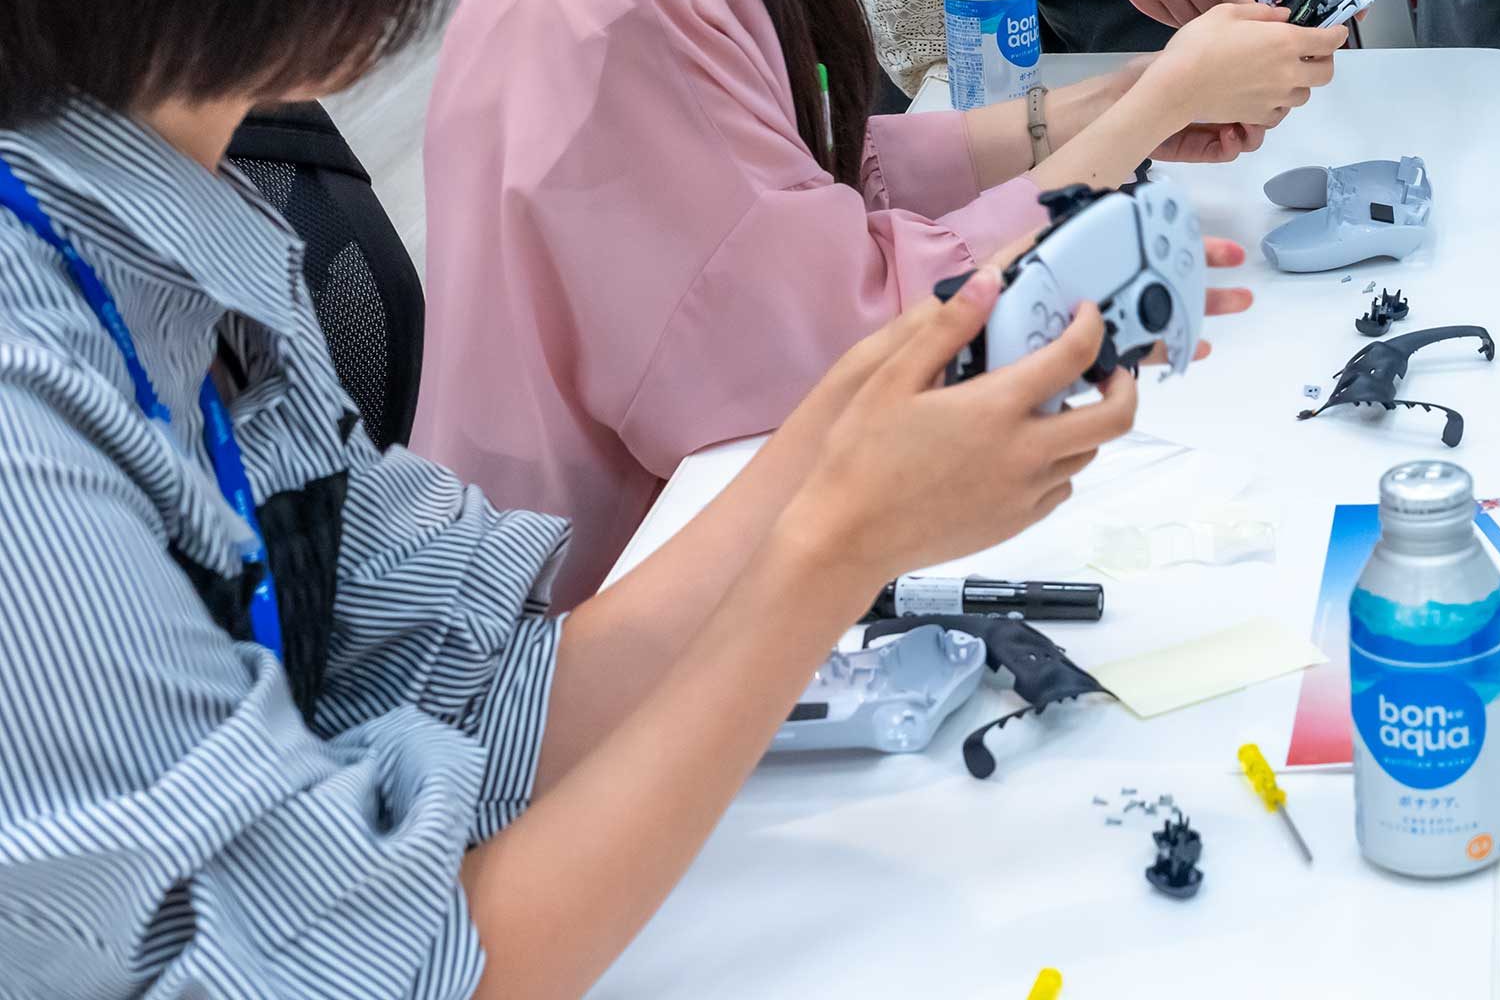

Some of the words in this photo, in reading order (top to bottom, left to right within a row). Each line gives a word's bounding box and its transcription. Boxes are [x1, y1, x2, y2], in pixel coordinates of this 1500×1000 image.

[1007, 14, 1036, 35] bon
[1379, 693, 1447, 728] bon
[1380, 724, 1470, 757] aqua
